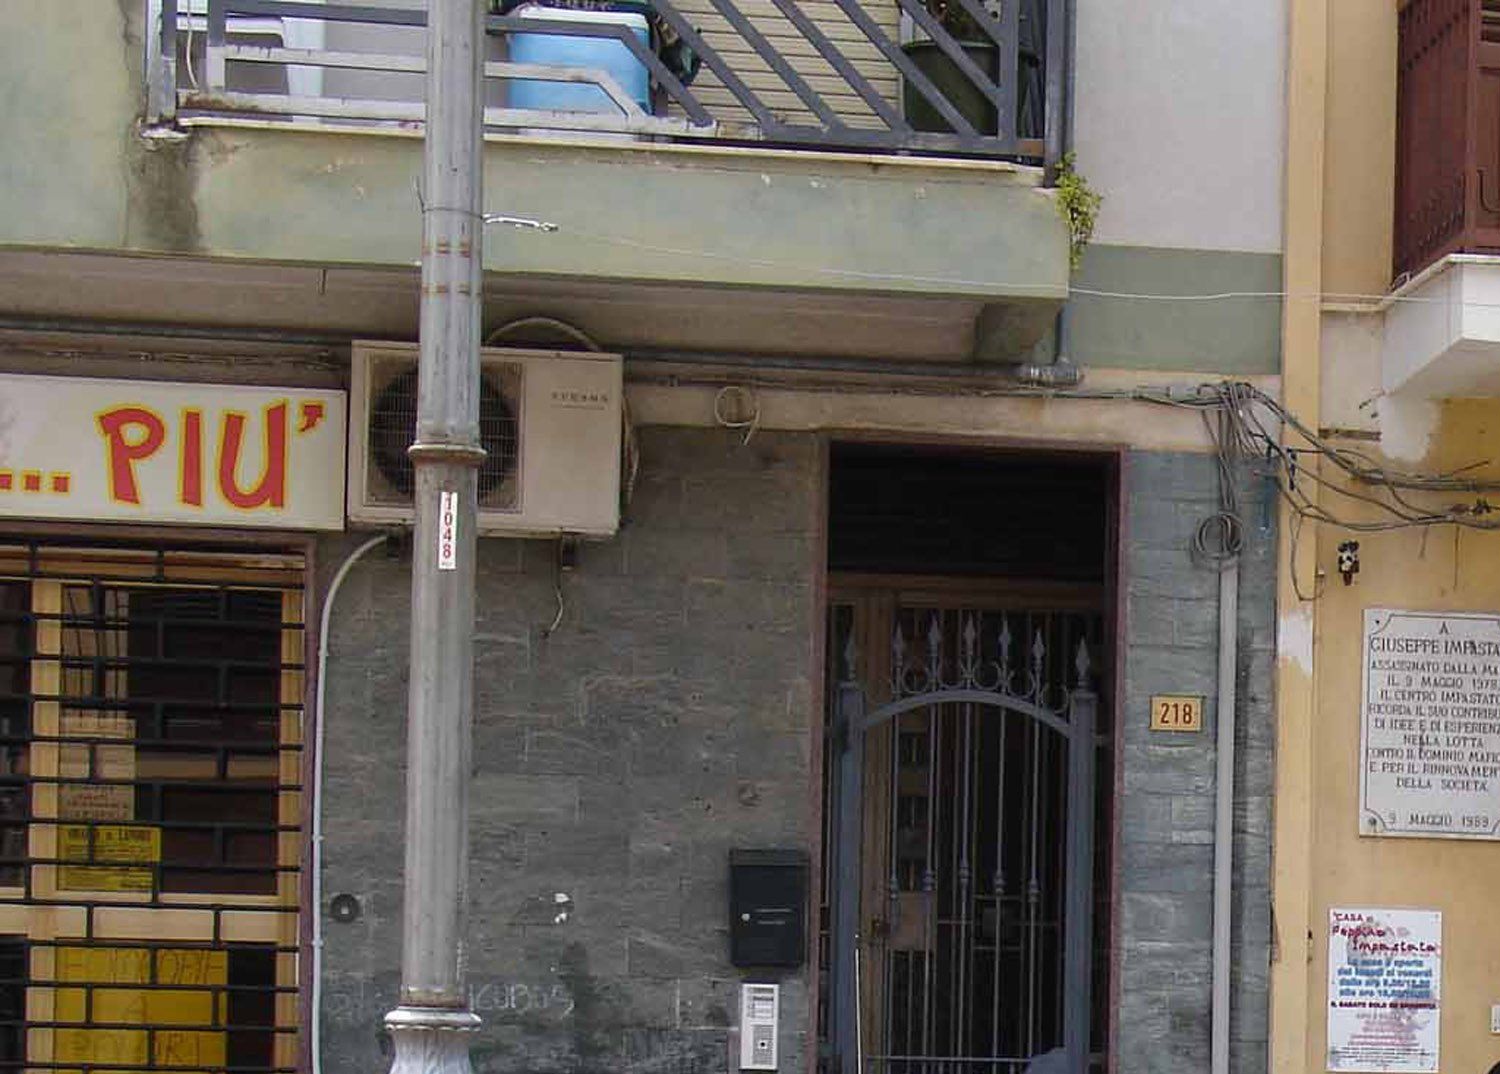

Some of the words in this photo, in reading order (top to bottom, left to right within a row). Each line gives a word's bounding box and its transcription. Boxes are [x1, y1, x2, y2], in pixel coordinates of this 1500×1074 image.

[95, 400, 324, 510] PIU'
[443, 492, 453, 559] 1048
[1438, 621, 1450, 635] A
[1370, 637, 1439, 654] GIUSEPPE
[1443, 662, 1477, 675] DALLA
[1387, 674, 1400, 687] IL
[1420, 676, 1464, 689] MAGGIO
[1380, 689, 1393, 700] IL
[1394, 690, 1437, 701] CENTRO
[1160, 702, 1193, 724] 218
[1369, 703, 1411, 715] RICORDA
[1415, 704, 1424, 716] IL
[1427, 705, 1449, 717] SUO
[1374, 718, 1386, 731] DI
[1389, 719, 1416, 732] IDEE
[1418, 719, 1428, 733] E
[1430, 720, 1441, 733] DI
[1403, 733, 1440, 747] NELLA
[1446, 735, 1484, 748] LOTTA
[1406, 748, 1416, 760] IL
[1418, 749, 1465, 762] DOMINIO
[1369, 761, 1378, 773] E
[1382, 761, 1404, 774] PER
[1406, 762, 1419, 775] IL
[1396, 776, 1433, 790] DELLA
[1408, 813, 1453, 827] MAGGIO
[1352, 937, 1436, 954] Impastato
